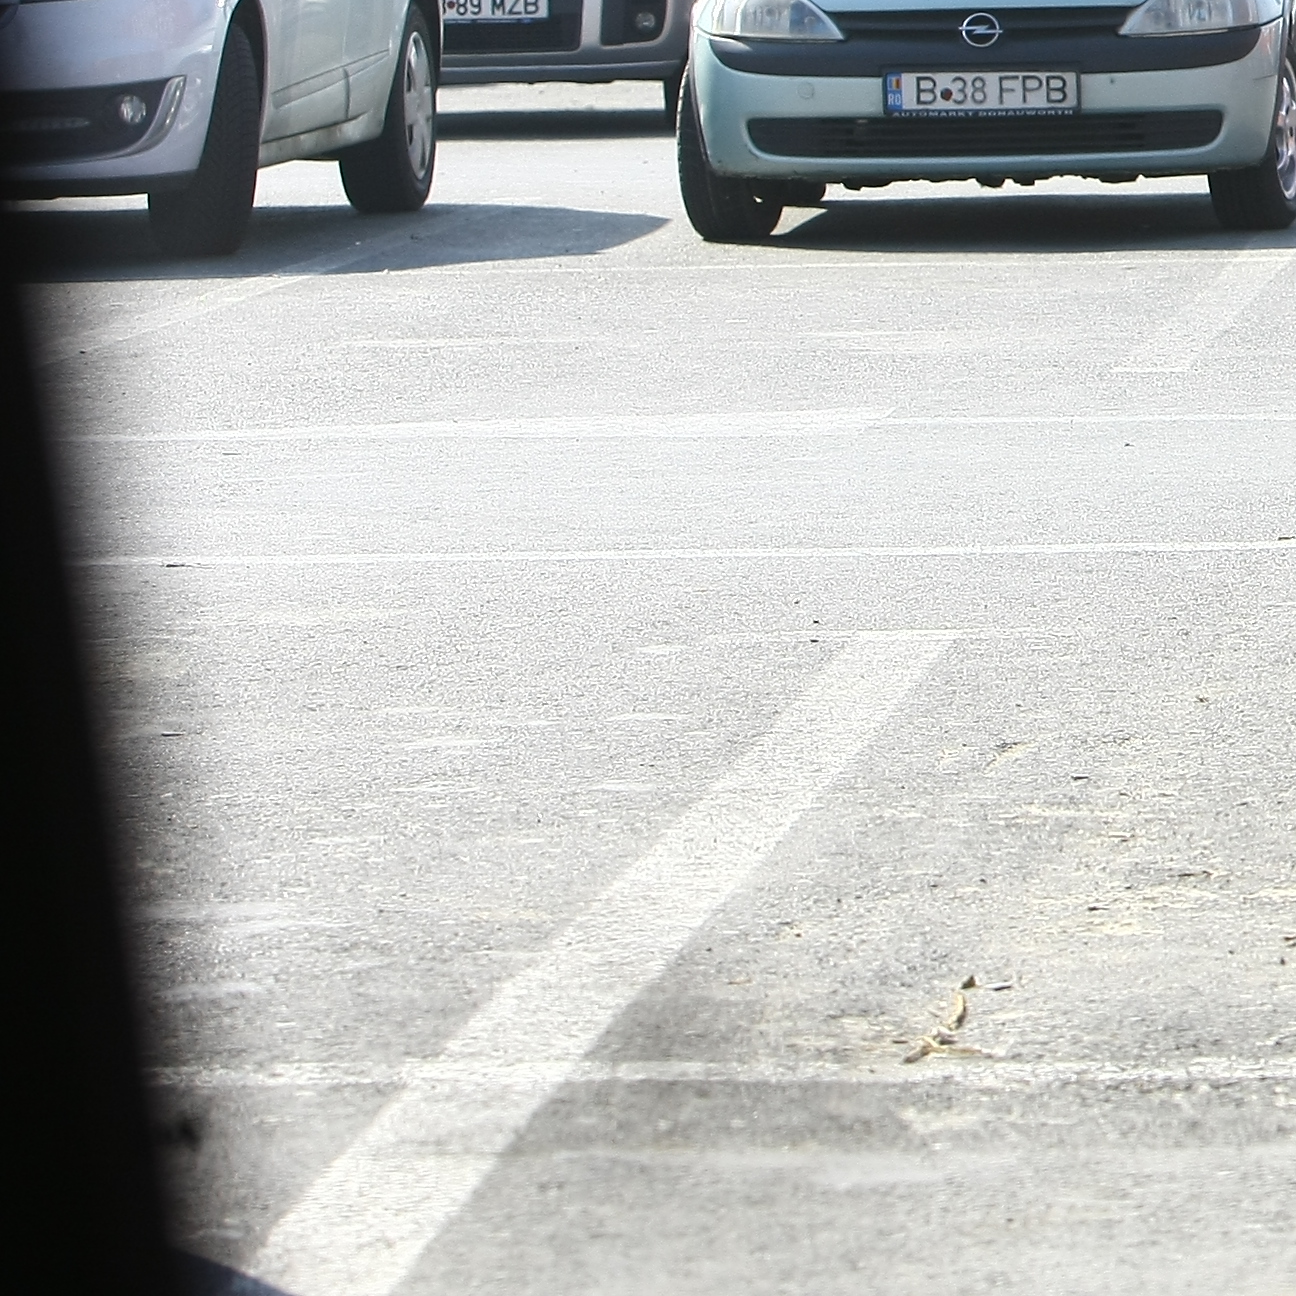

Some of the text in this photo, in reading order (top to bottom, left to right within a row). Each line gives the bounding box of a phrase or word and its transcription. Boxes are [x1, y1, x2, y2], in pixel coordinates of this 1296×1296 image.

[887, 93, 902, 106] RO
[915, 74, 1068, 105] B 38 FPB
